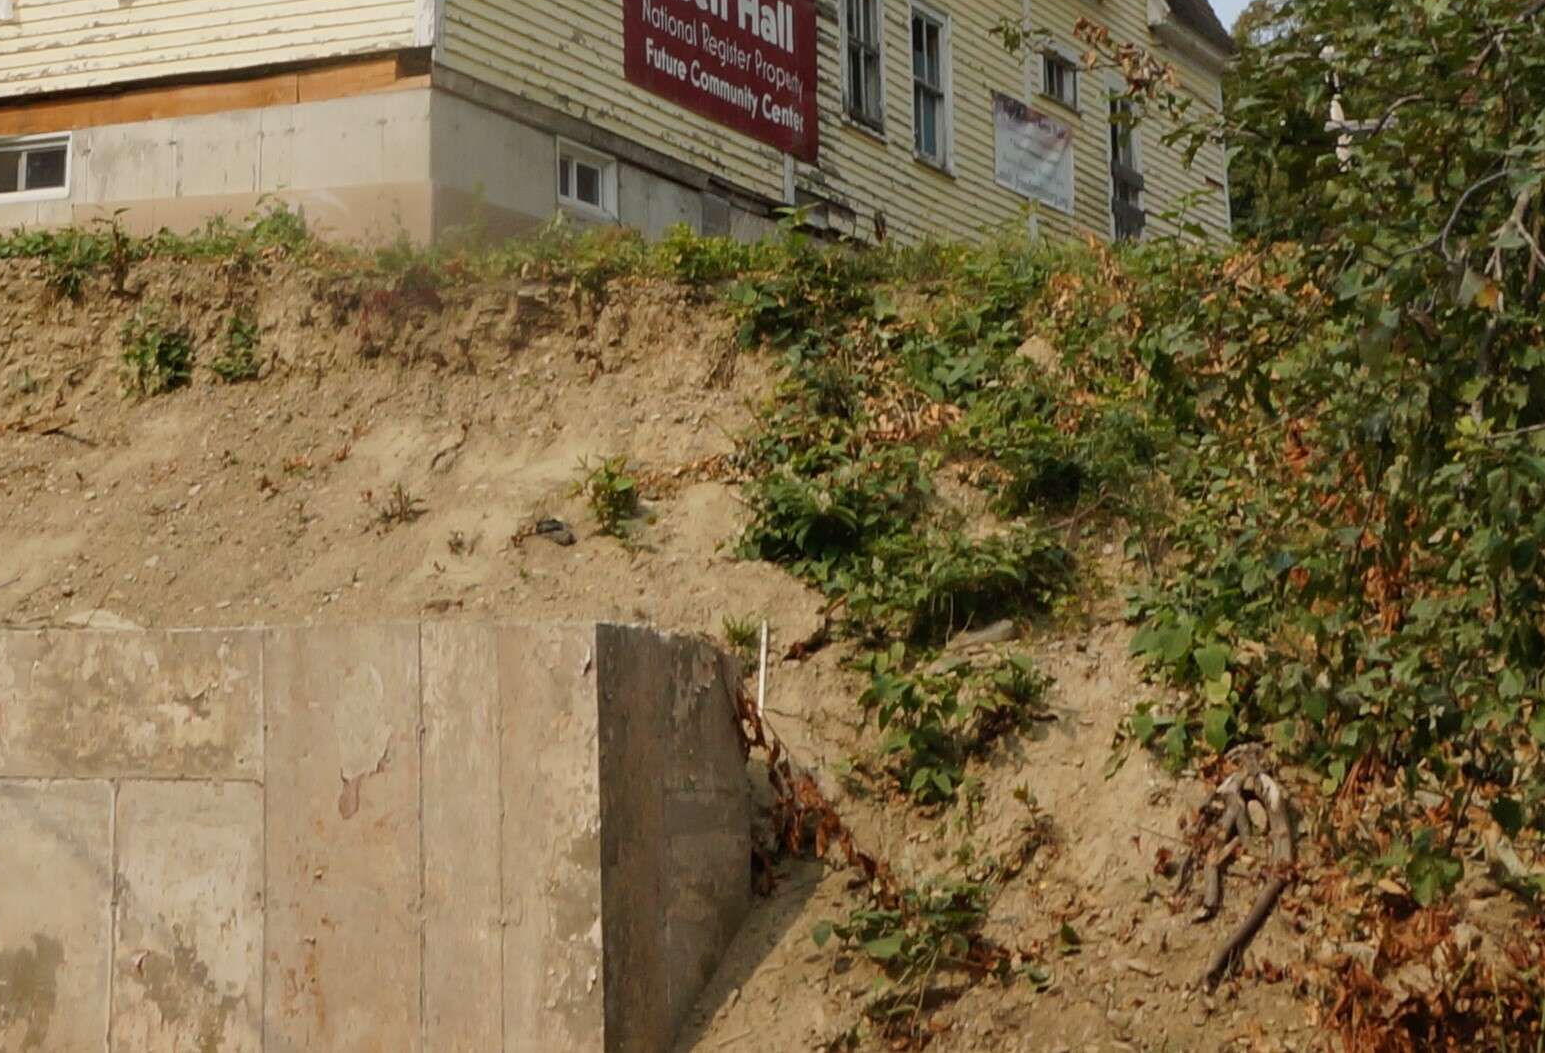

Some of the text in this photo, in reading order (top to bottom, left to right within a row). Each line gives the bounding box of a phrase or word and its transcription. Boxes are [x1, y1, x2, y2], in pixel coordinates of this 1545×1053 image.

[646, 37, 803, 133] Future Community Center
[702, 23, 751, 71] Register
[755, 50, 803, 102] Property
